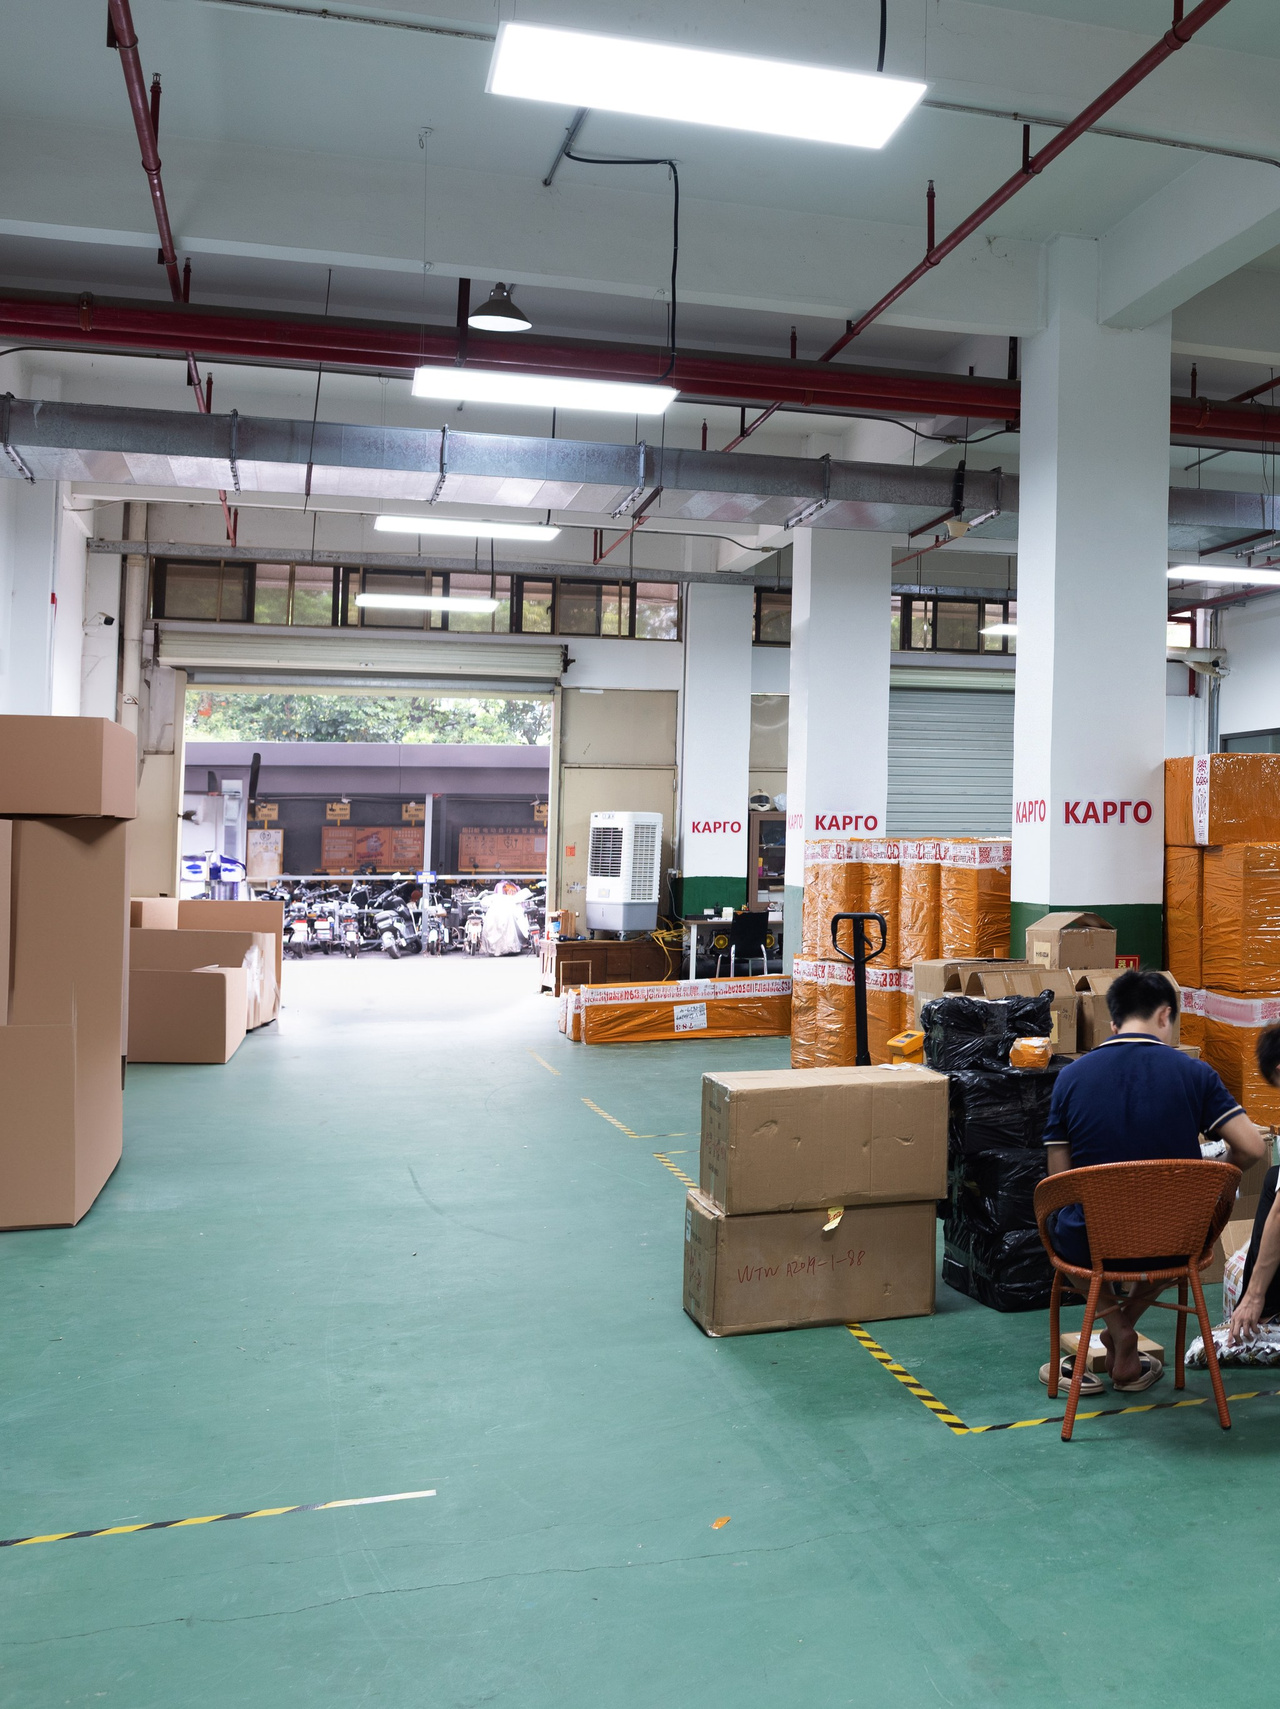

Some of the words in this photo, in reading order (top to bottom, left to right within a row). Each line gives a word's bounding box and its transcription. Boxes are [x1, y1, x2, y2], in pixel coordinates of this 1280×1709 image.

[1016, 799, 1046, 824] КАРГО
[1064, 801, 1152, 824] КАРГО
[691, 821, 741, 833] КАРГО
[815, 815, 878, 831] КАРГО
